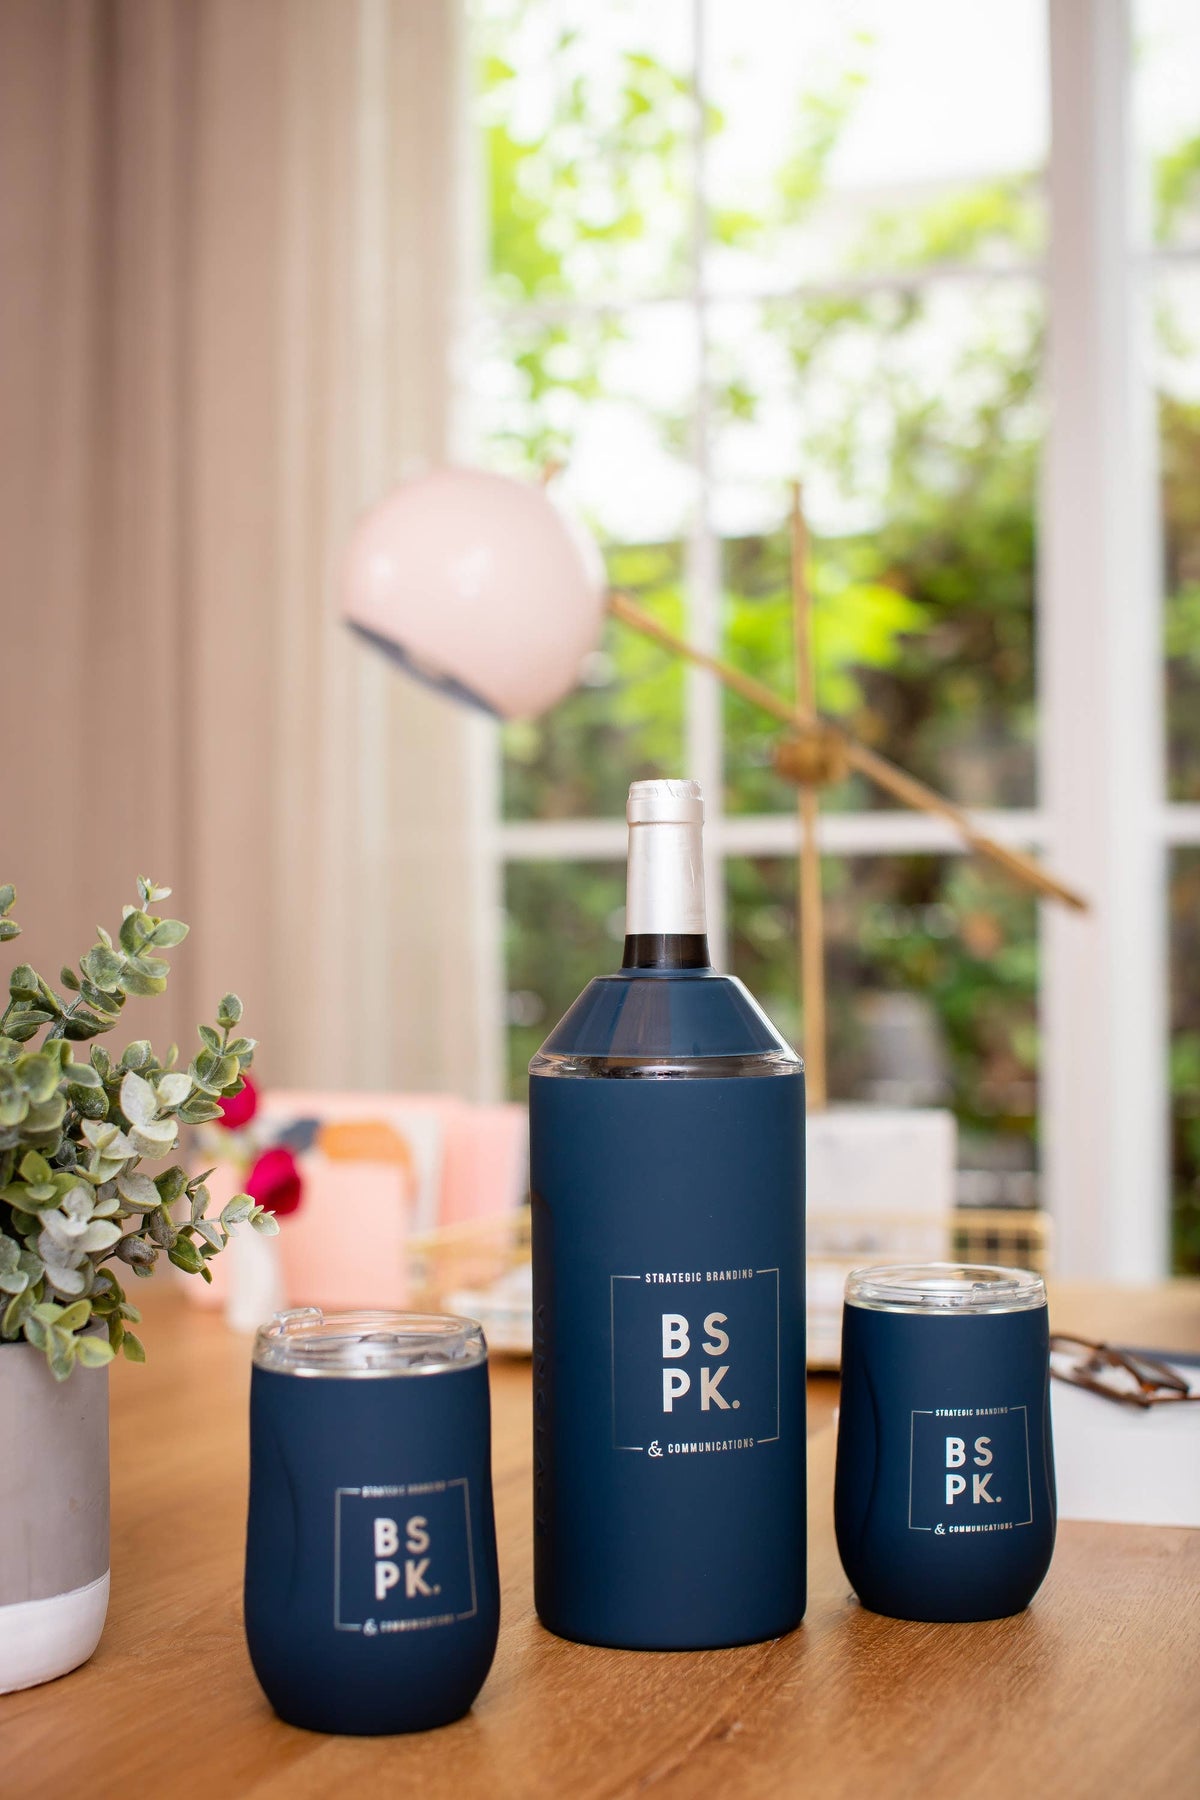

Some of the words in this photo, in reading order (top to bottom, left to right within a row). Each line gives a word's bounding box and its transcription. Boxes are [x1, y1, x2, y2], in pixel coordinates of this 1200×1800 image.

[645, 1272, 701, 1283] STRATEGIC
[706, 1269, 753, 1282] BRANDING
[935, 1409, 974, 1417] STRATEGIC
[975, 1407, 1009, 1416] BRANDING
[648, 1440, 663, 1457] &
[668, 1438, 754, 1454] COMMUNICATIONS
[934, 1523, 946, 1536] &
[948, 1522, 1013, 1534] COMMUNICATIONS
